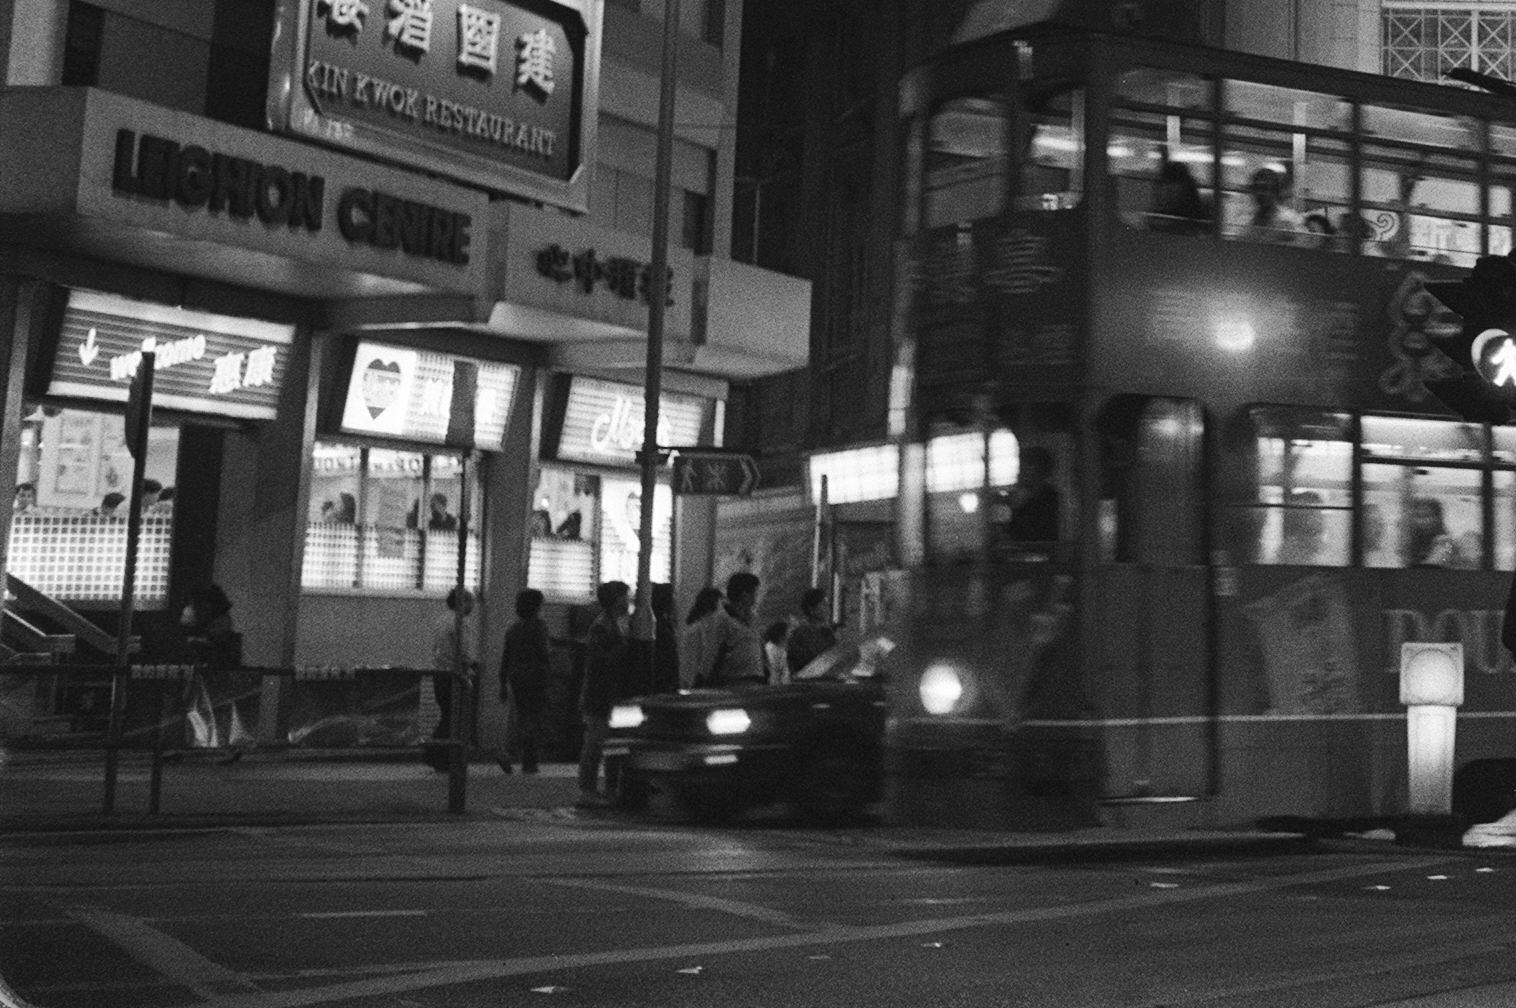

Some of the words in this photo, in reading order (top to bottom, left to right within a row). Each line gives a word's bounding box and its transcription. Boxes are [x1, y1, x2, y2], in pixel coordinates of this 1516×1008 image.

[306, 60, 349, 96] KIN
[355, 72, 420, 117] KWOK
[425, 95, 558, 156] RESTAURANT
[114, 128, 324, 233] LEIGHTON
[336, 186, 472, 265] CENTRE
